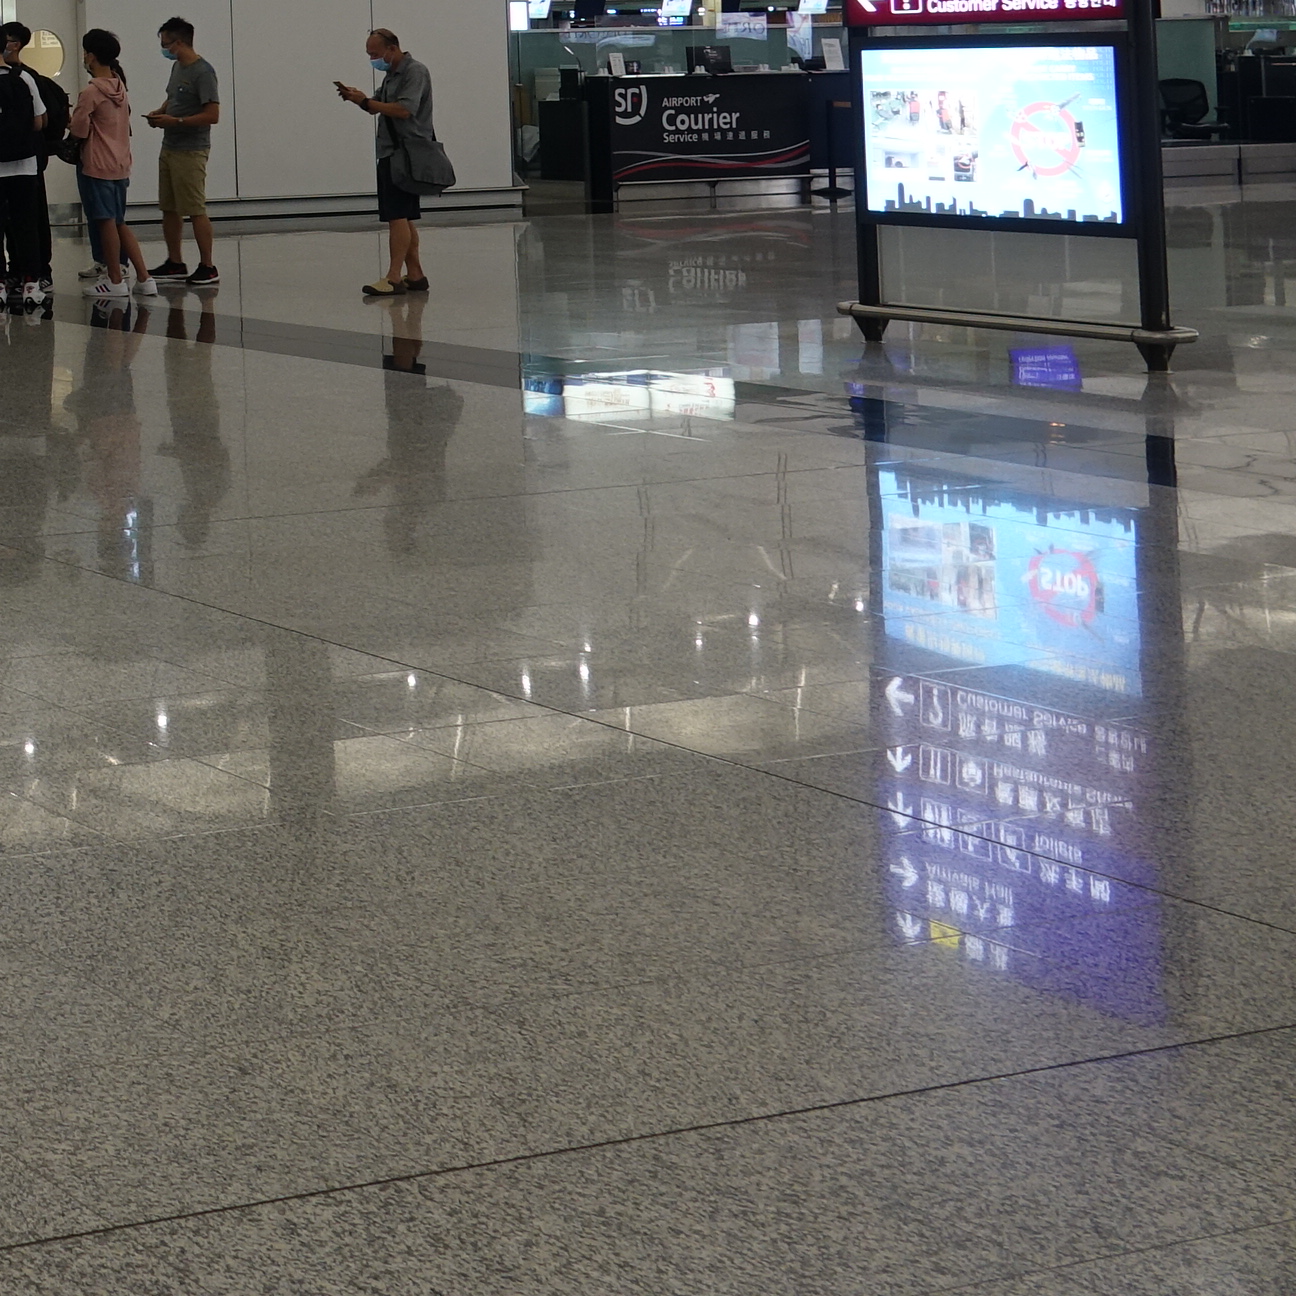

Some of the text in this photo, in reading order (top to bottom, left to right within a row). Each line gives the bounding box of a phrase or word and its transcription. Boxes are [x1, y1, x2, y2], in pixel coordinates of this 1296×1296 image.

[661, 96, 702, 108] AIRPORT
[661, 107, 740, 131] Courier
[663, 131, 698, 143] Service
